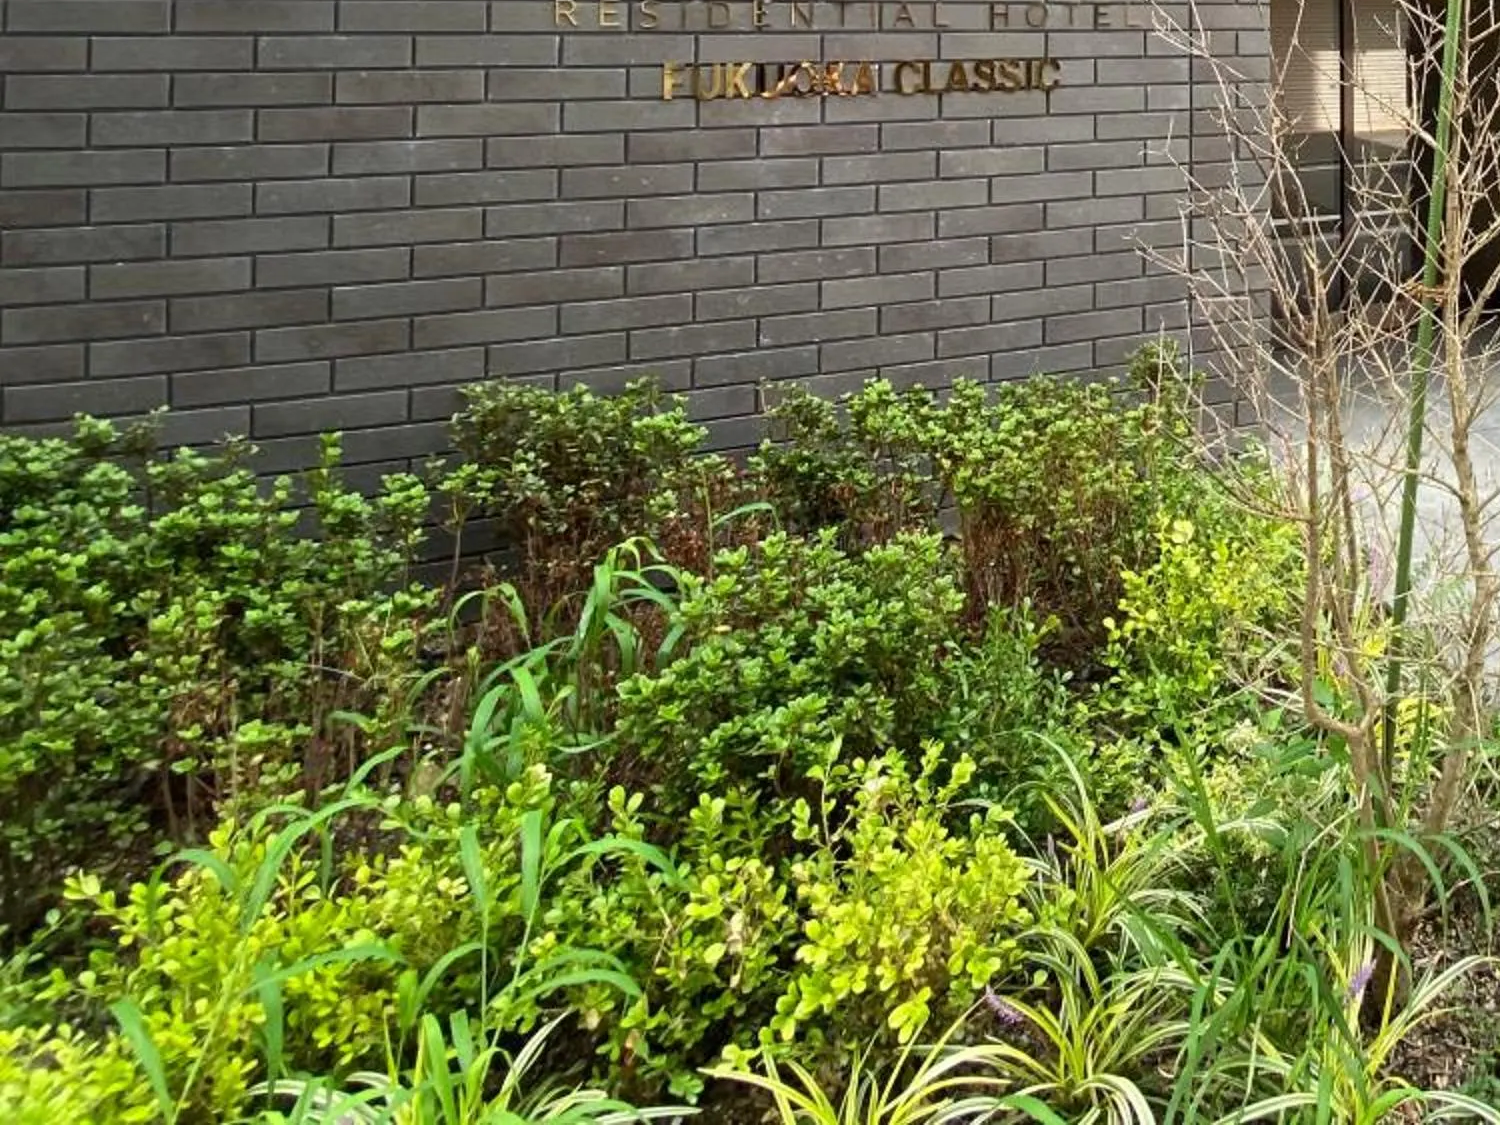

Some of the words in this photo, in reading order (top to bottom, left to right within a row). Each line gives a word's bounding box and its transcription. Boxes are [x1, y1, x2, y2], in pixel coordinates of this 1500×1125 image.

[989, 2, 1146, 28] HOTEL
[662, 59, 878, 101] FUKUOKA
[893, 58, 1062, 96] CLASSIC
